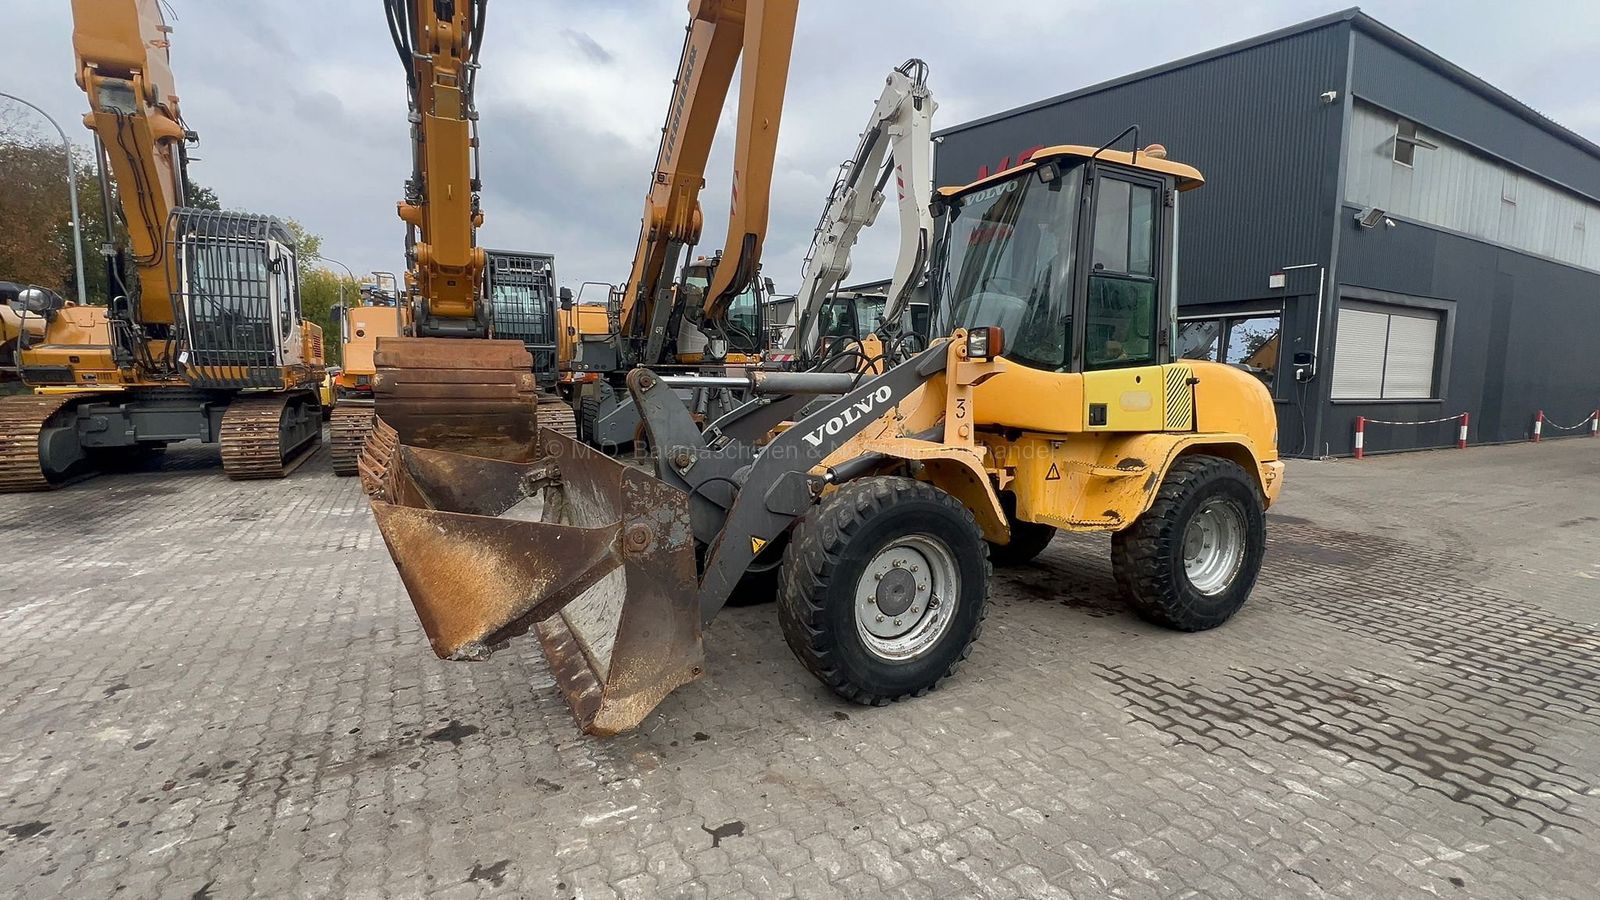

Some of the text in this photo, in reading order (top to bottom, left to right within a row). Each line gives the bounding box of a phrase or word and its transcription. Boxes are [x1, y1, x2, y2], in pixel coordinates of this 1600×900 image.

[664, 44, 698, 165] LIEBHERR
[963, 179, 1019, 207] VOLVO
[802, 385, 892, 447] VOLVO
[955, 398, 966, 419] 3
